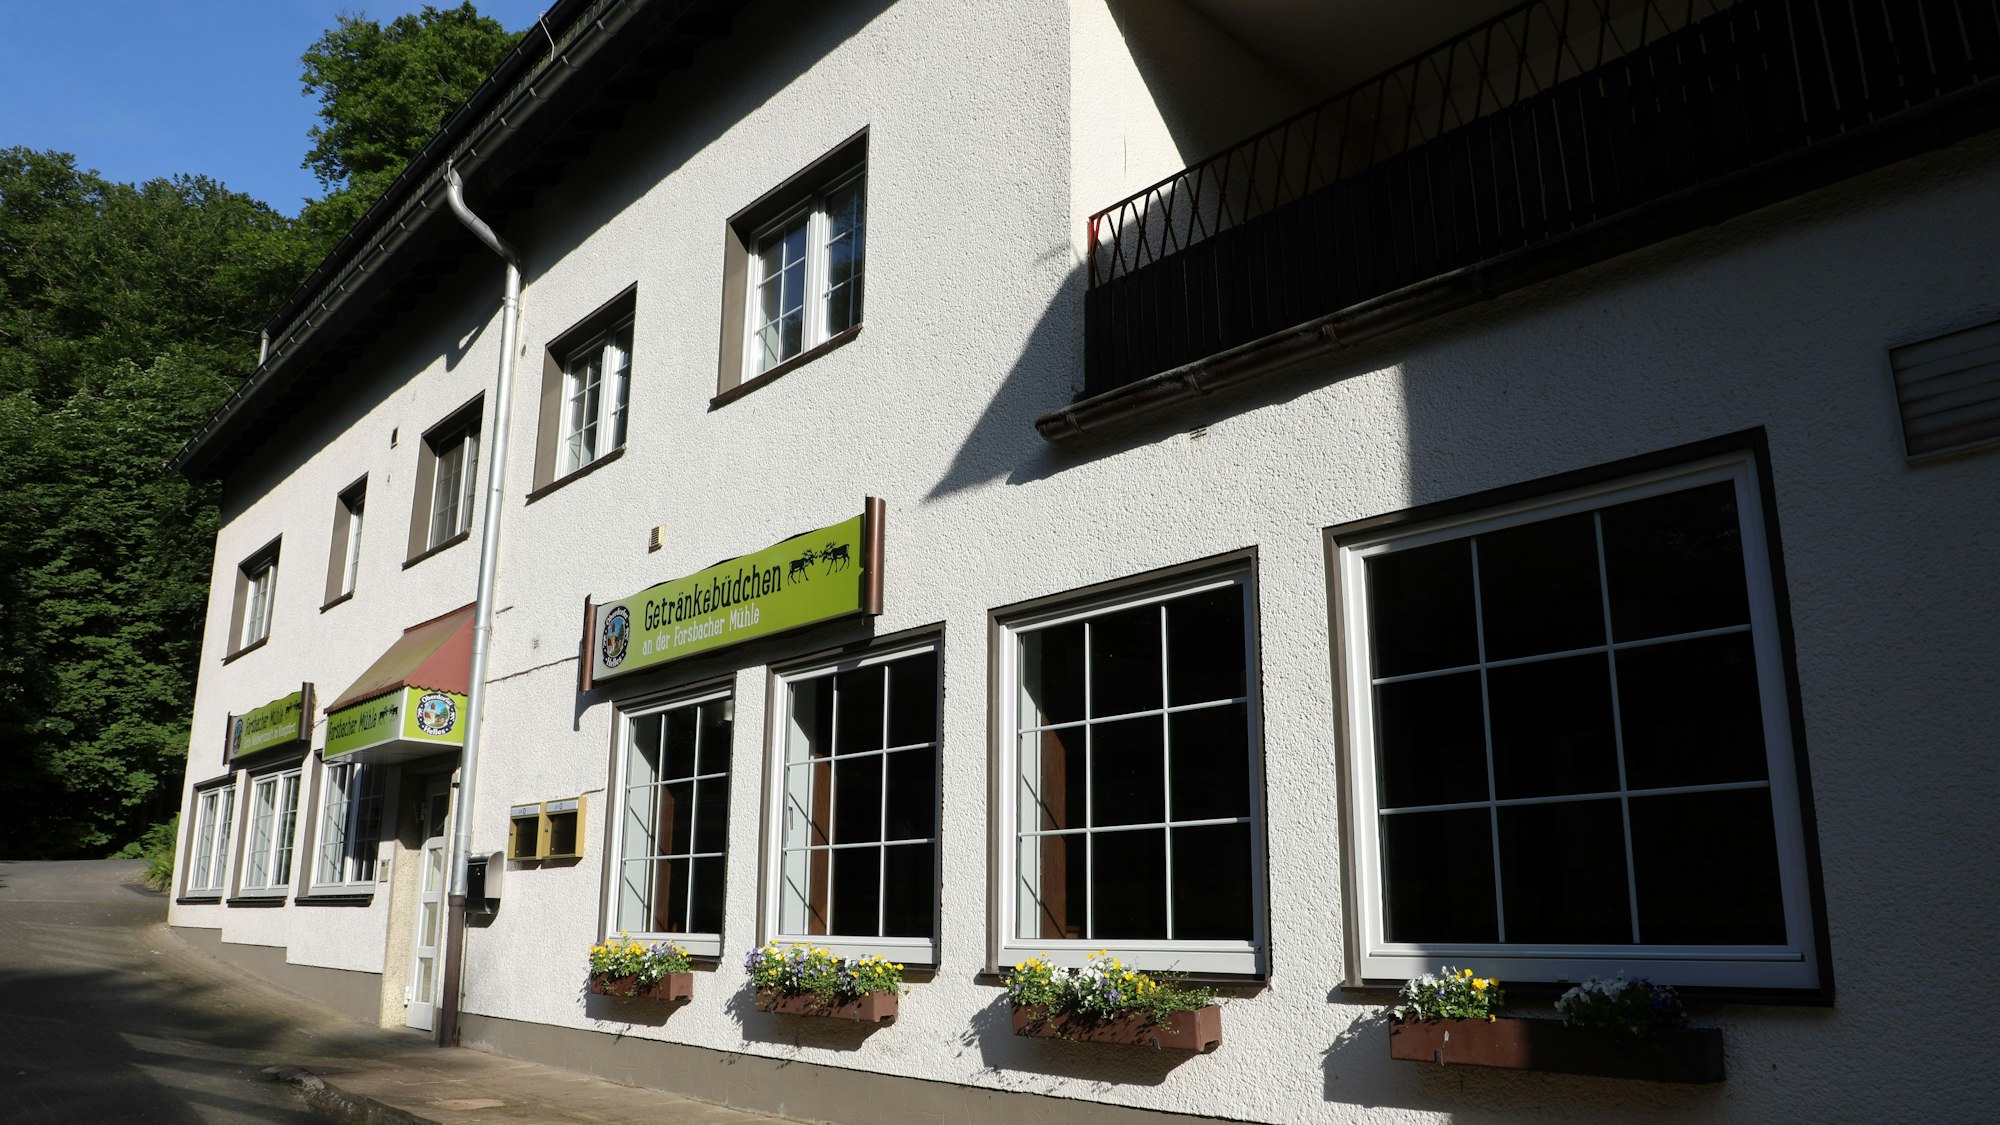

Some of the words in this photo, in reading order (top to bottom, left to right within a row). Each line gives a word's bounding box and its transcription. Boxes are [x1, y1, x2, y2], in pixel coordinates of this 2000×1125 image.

[644, 564, 782, 631] Getränkebüdchen
[642, 639, 654, 656] an
[655, 630, 671, 652] der
[673, 616, 725, 648] Forsbacher
[729, 602, 760, 632] Mühle
[327, 715, 357, 742] Forsbacher
[358, 707, 378, 733] Mühle
[423, 726, 446, 735] Helles
